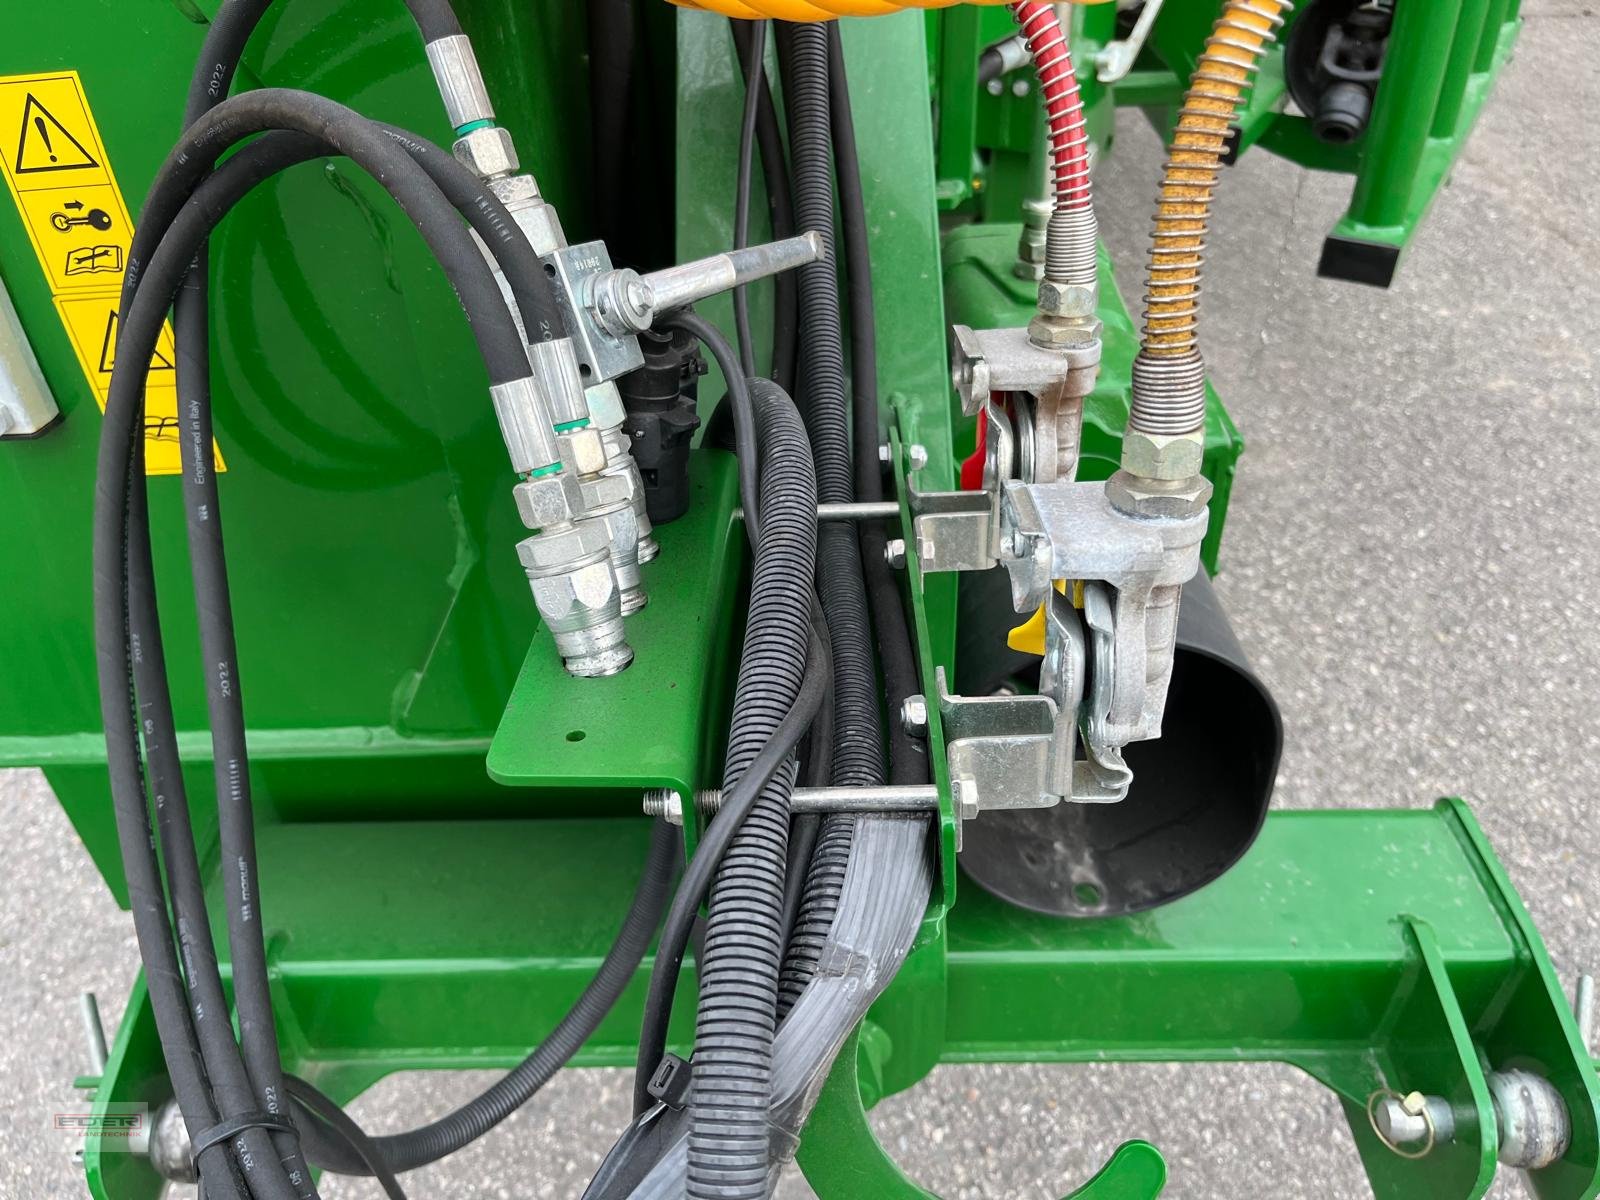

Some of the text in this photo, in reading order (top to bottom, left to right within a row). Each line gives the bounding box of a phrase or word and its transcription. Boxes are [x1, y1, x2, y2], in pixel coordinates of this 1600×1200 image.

[208, 63, 226, 96] 2022
[128, 258, 140, 288] 2022
[188, 400, 206, 485] Engineered in Italy
[132, 633, 143, 663] 2022
[218, 661, 232, 697] 2022
[236, 1138, 254, 1171] 2022
